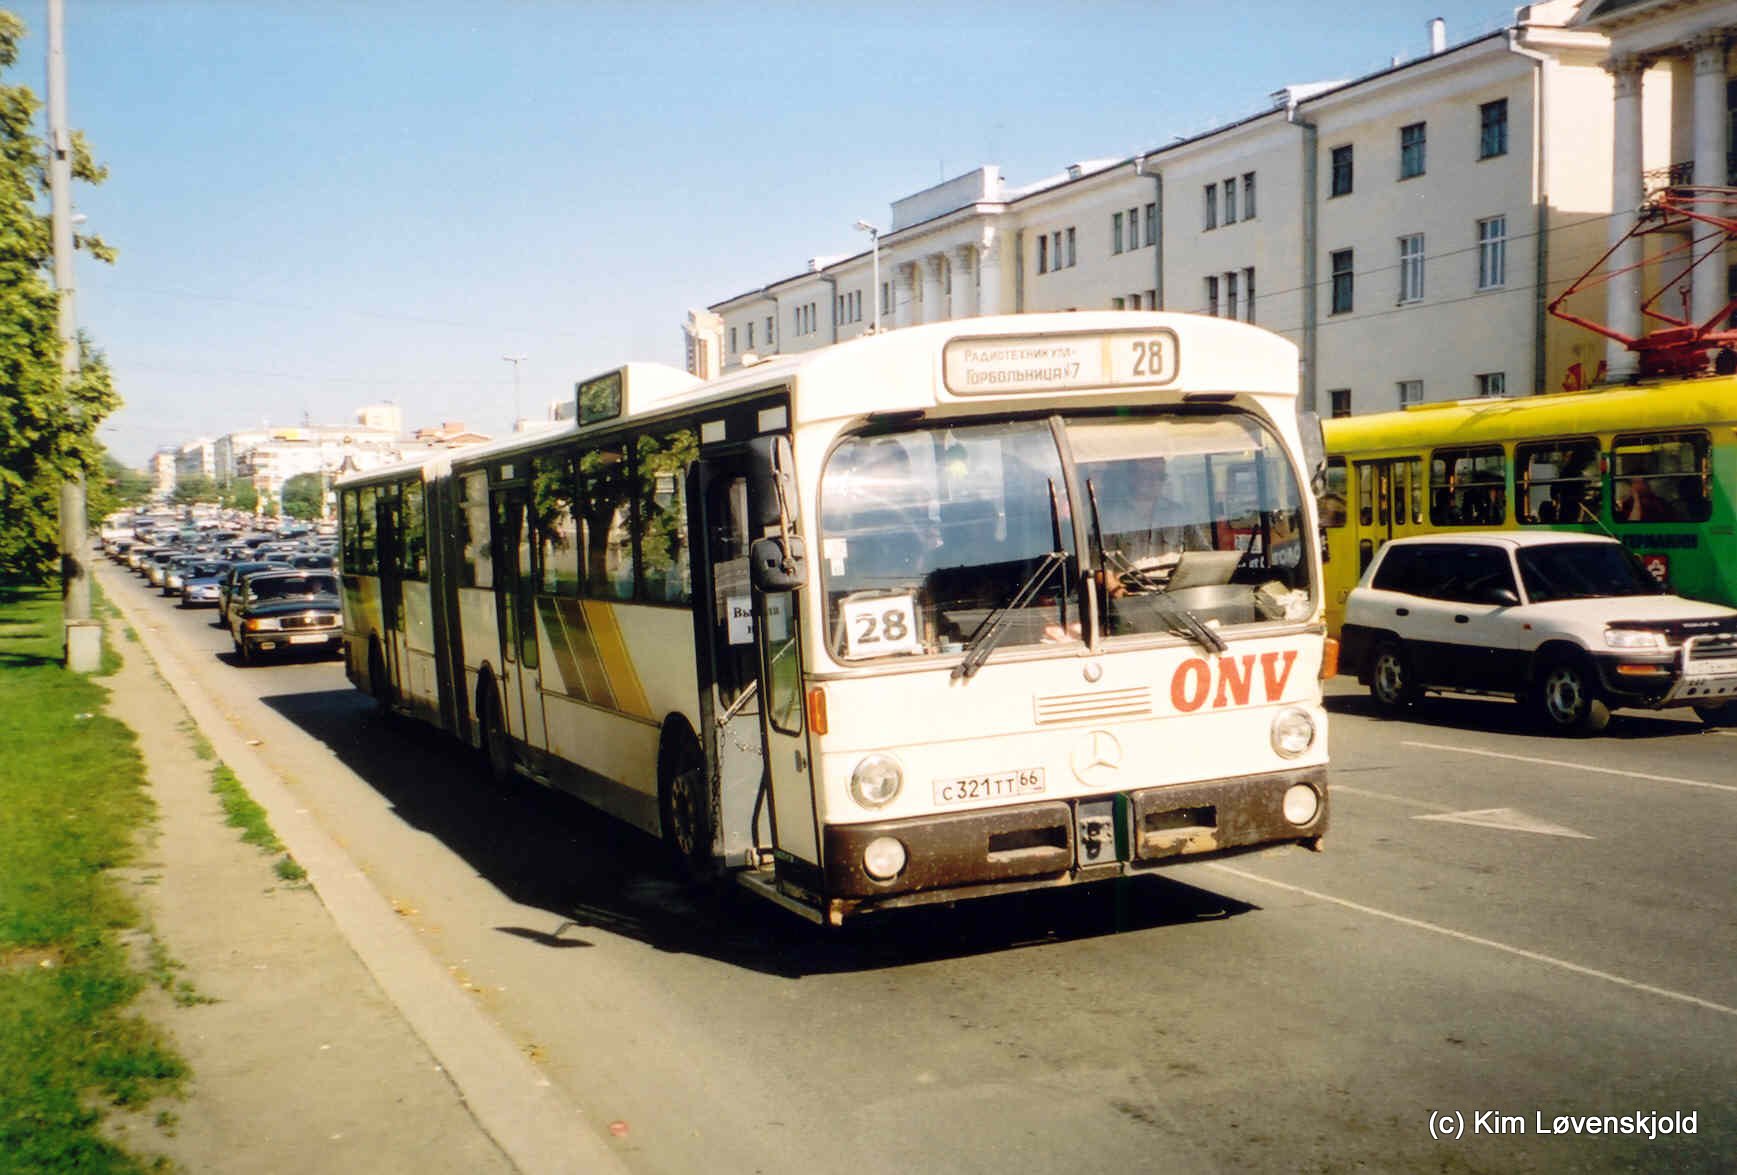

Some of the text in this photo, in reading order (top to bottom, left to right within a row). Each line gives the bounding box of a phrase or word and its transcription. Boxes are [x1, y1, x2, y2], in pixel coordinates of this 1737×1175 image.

[1132, 340, 1163, 377] 28
[855, 609, 909, 644] 28
[1170, 650, 1298, 713] ONV
